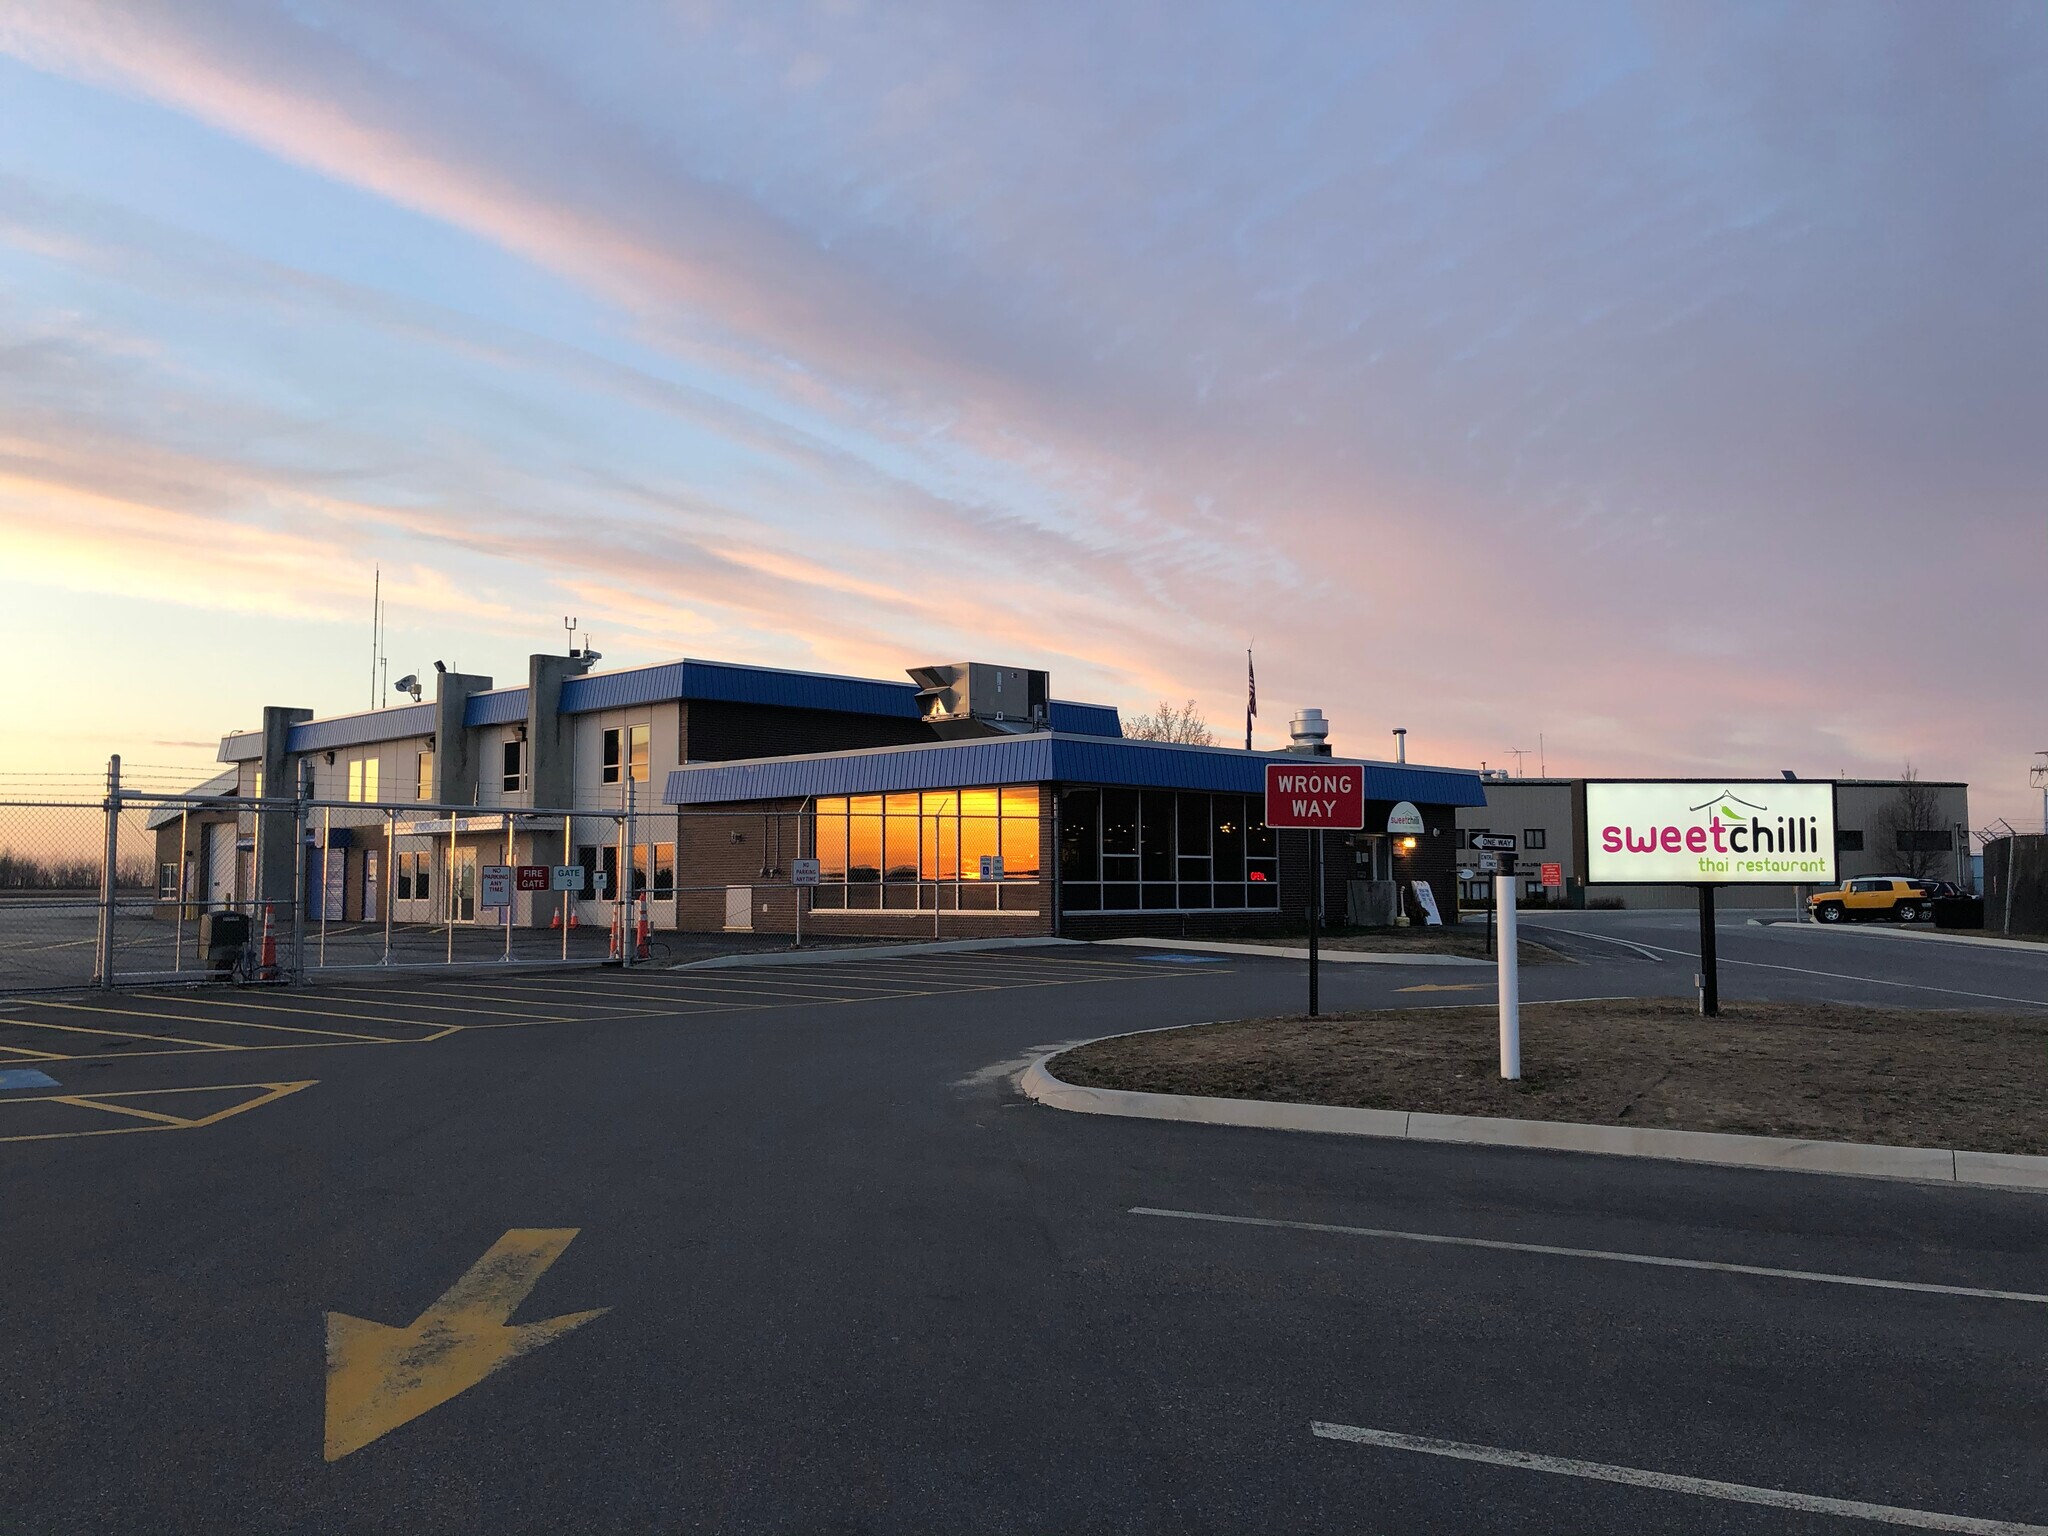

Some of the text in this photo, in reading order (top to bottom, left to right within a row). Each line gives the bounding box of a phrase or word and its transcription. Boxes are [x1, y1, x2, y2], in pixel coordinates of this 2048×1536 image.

[1278, 775, 1352, 794] WRONG
[1292, 800, 1337, 818] WAY
[1602, 816, 1818, 853] sweetchilli
[1483, 838, 1496, 846] ONE
[1698, 857, 1826, 872] thai restaurant
[523, 869, 543, 877] FIRE
[558, 869, 580, 877] GATE
[521, 880, 545, 888] GATE
[566, 879, 573, 887] 3
